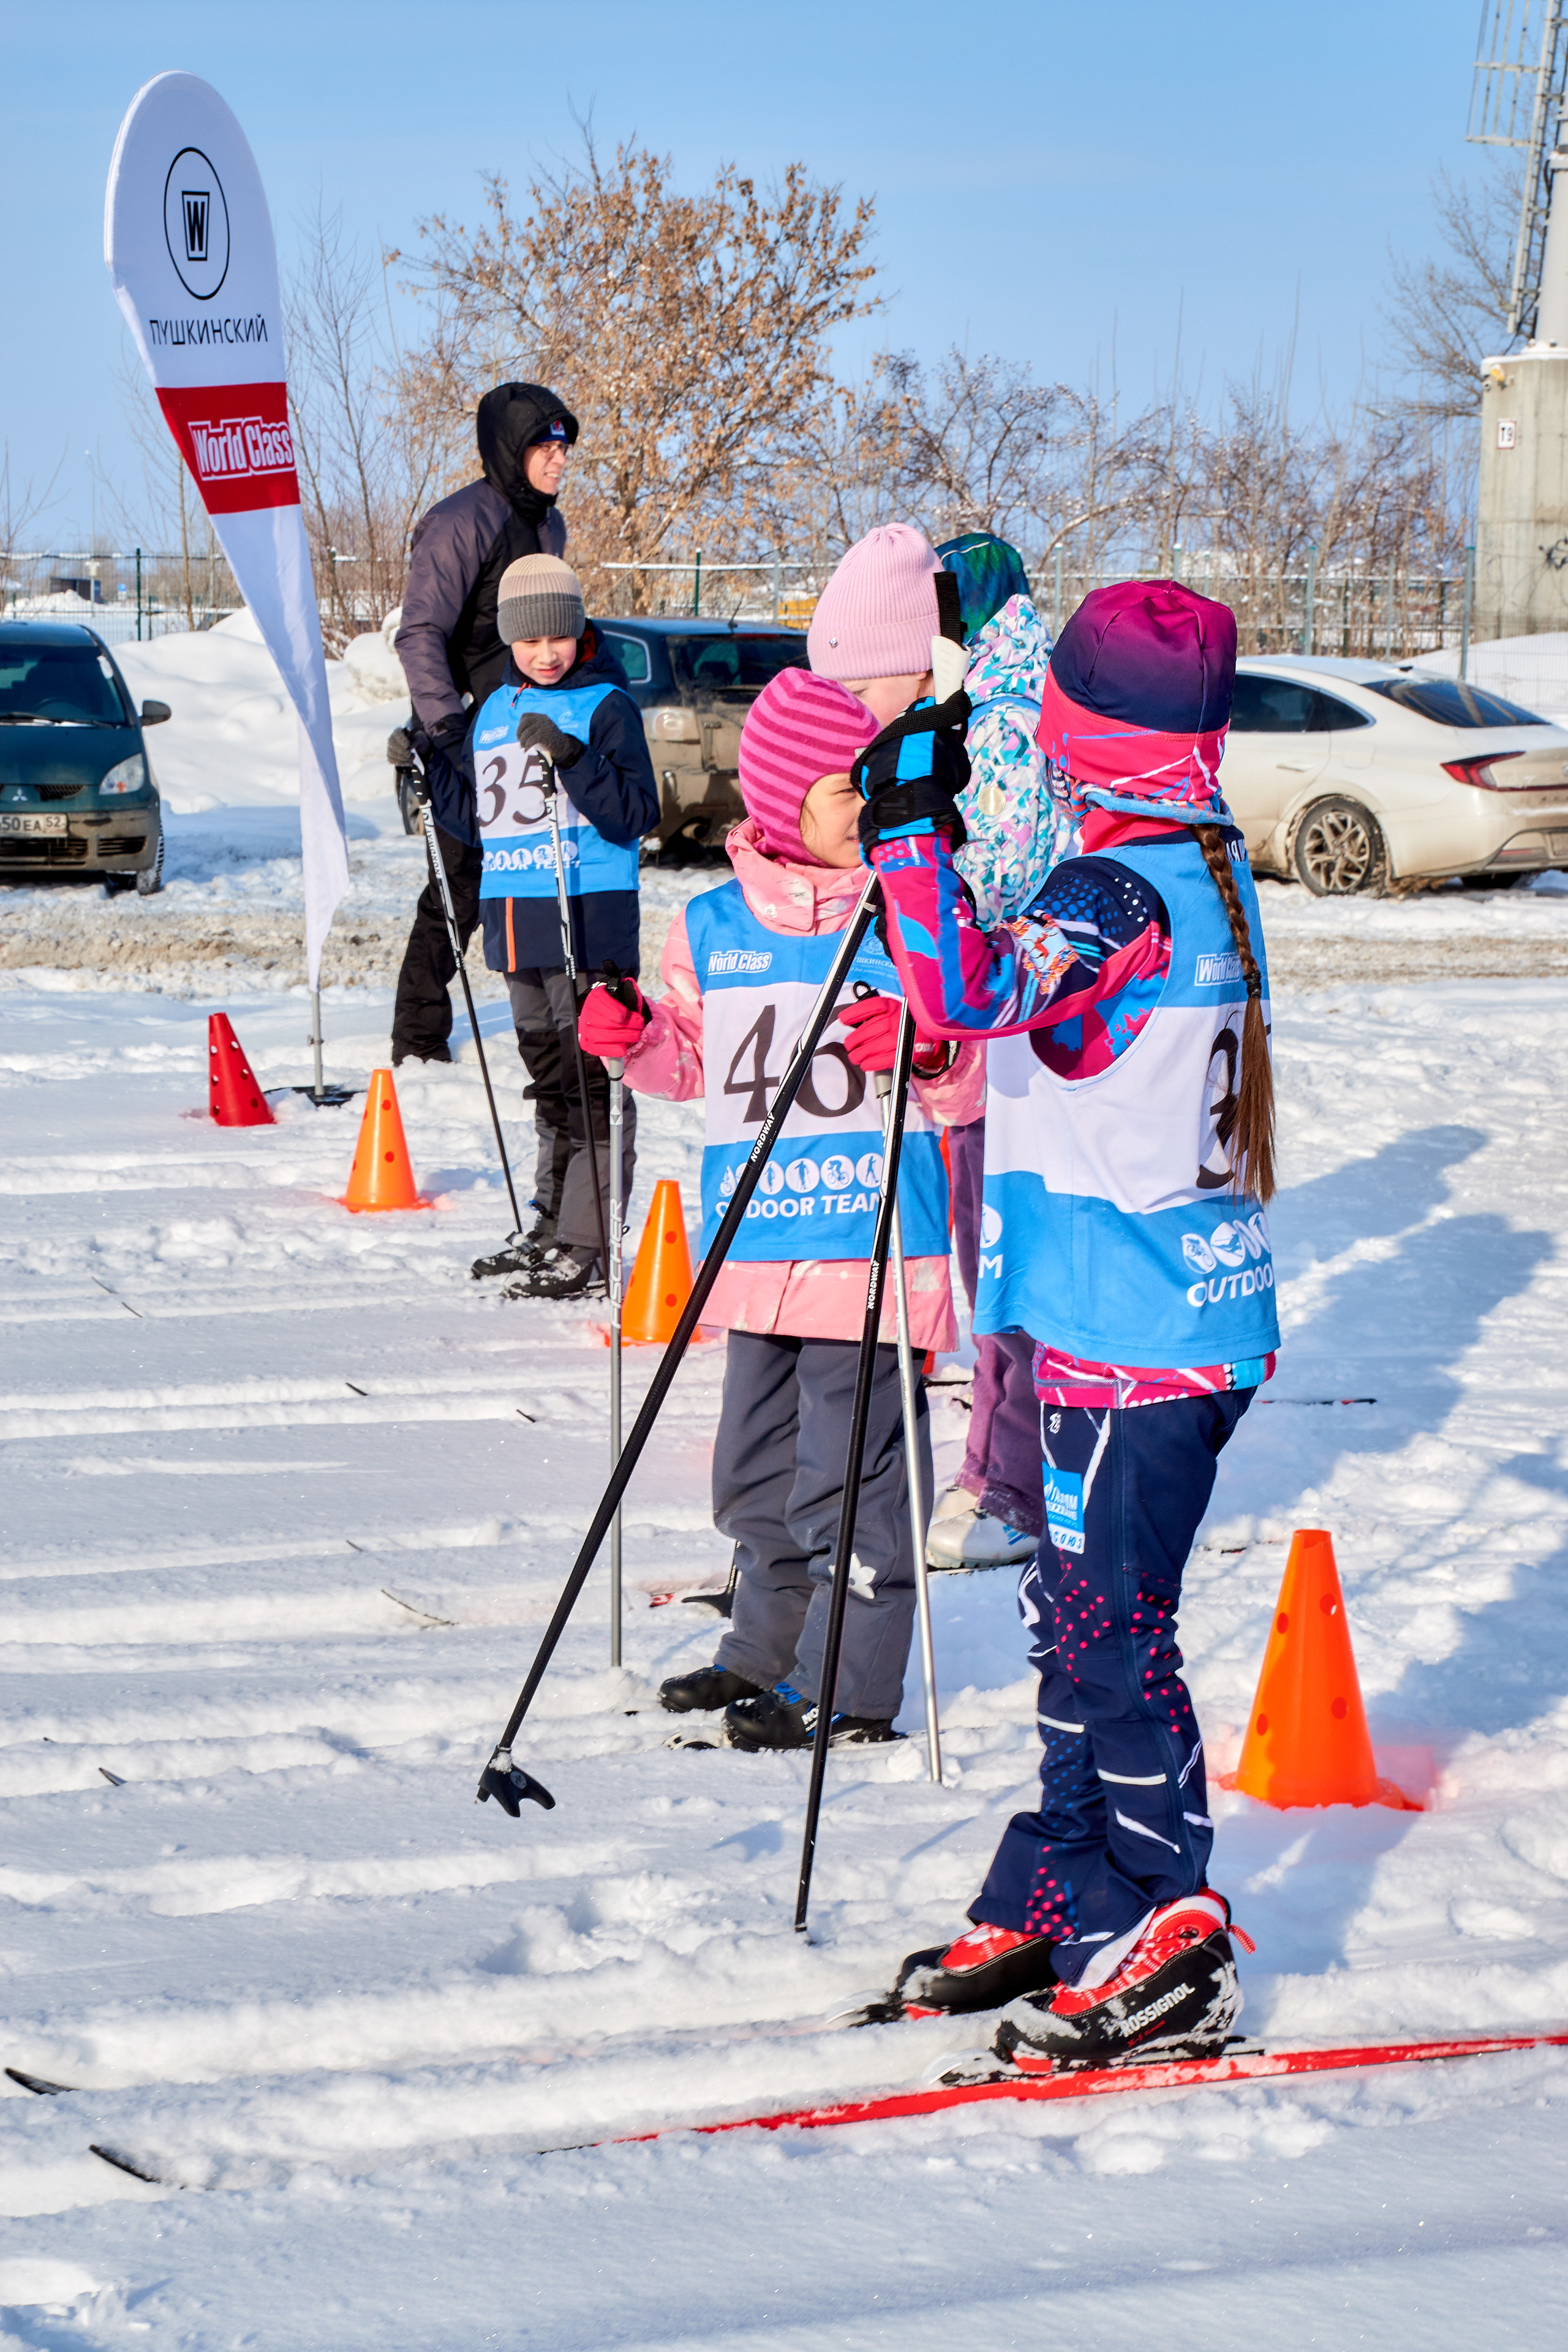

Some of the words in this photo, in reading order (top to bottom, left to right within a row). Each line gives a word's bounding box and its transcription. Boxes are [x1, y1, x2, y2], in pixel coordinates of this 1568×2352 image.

[149, 313, 268, 345] ПУШКИНСКИЙ
[192, 426, 247, 473] World
[244, 424, 293, 467] Class
[479, 751, 549, 827] 35
[737, 953, 770, 971] Class
[724, 1003, 866, 1123] 46
[750, 1112, 775, 1163] NORDWAY
[715, 1196, 815, 1218] ODOOR
[609, 1198, 622, 1329] FISCHER
[867, 1260, 880, 1310] NORDWAY
[1187, 1262, 1273, 1307] OUTDOO
[1118, 1982, 1196, 2038] ROSSIGNOL
